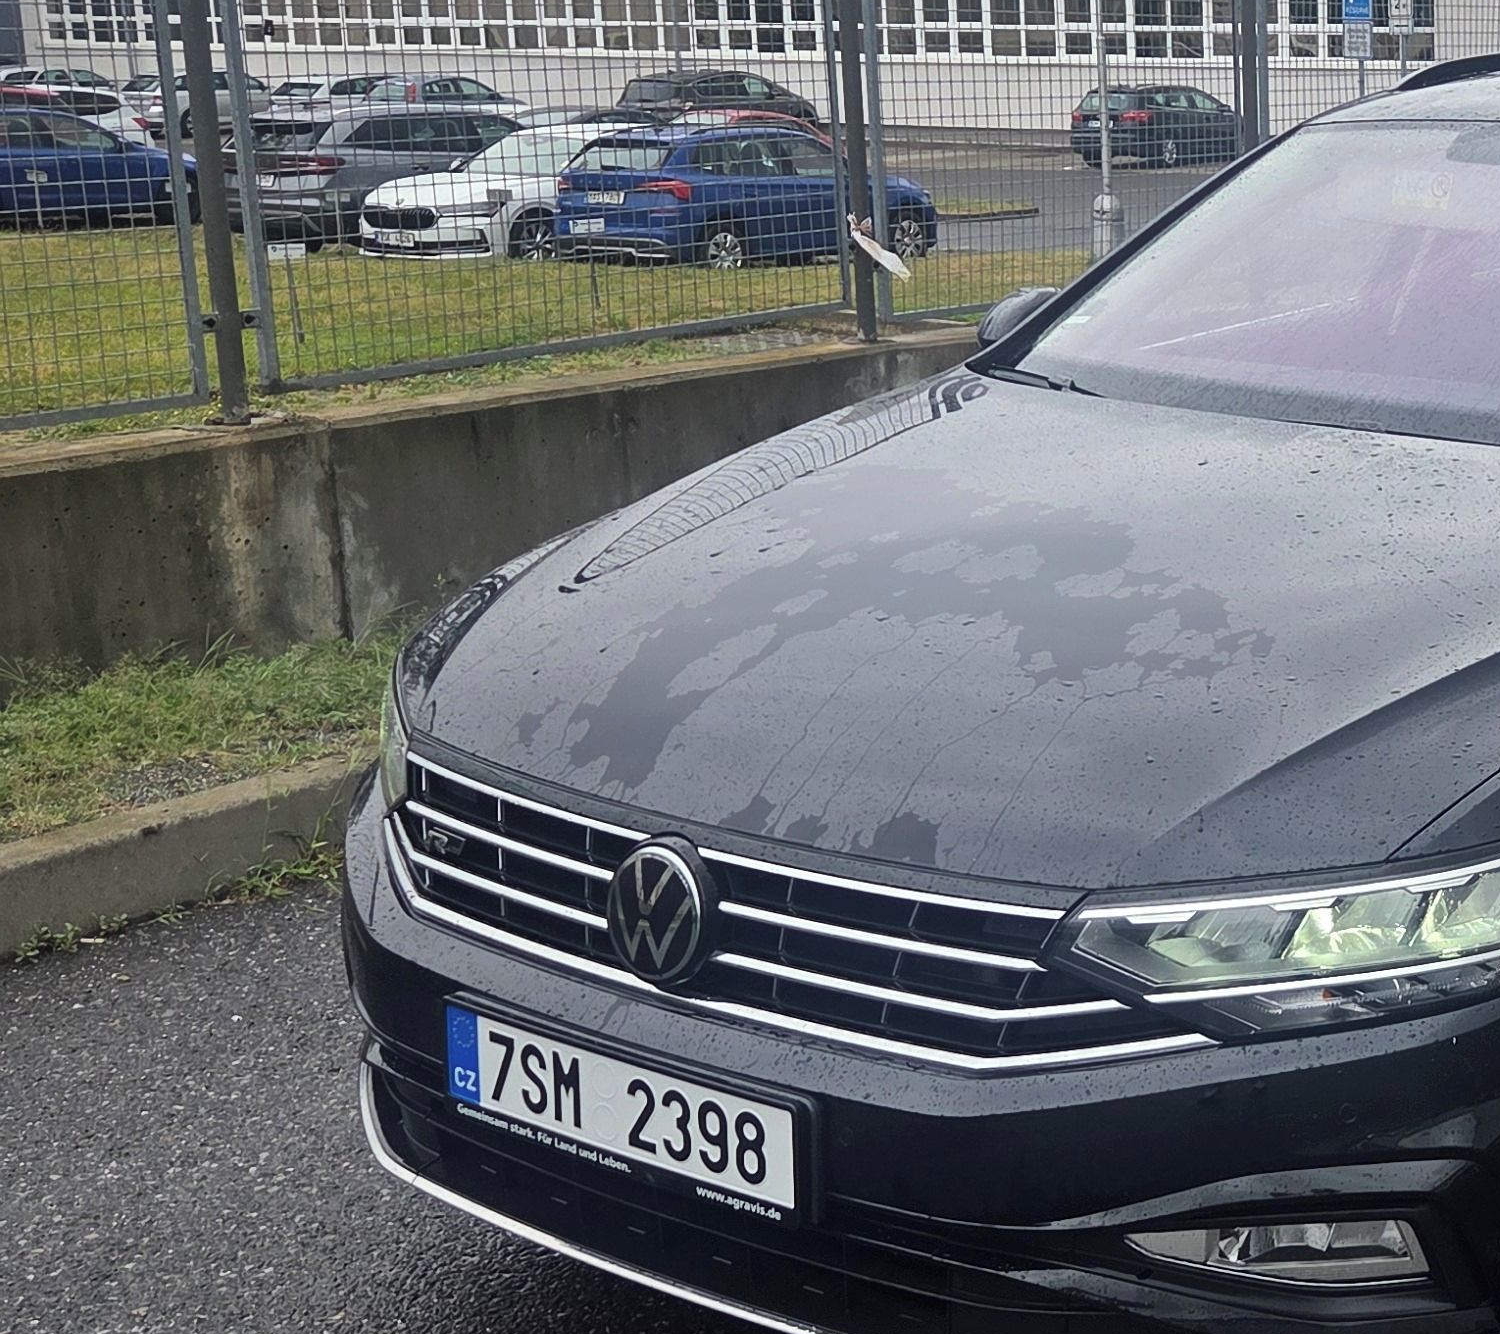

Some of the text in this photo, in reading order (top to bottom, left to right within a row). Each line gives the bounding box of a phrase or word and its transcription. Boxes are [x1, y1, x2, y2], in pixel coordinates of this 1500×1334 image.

[454, 1066, 477, 1092] CZ
[488, 1030, 767, 1186] 7SM 2398
[456, 1103, 632, 1173] Gemeinsam stark. Für Land und Leben.
[695, 1186, 782, 1221] www.agravis.de
